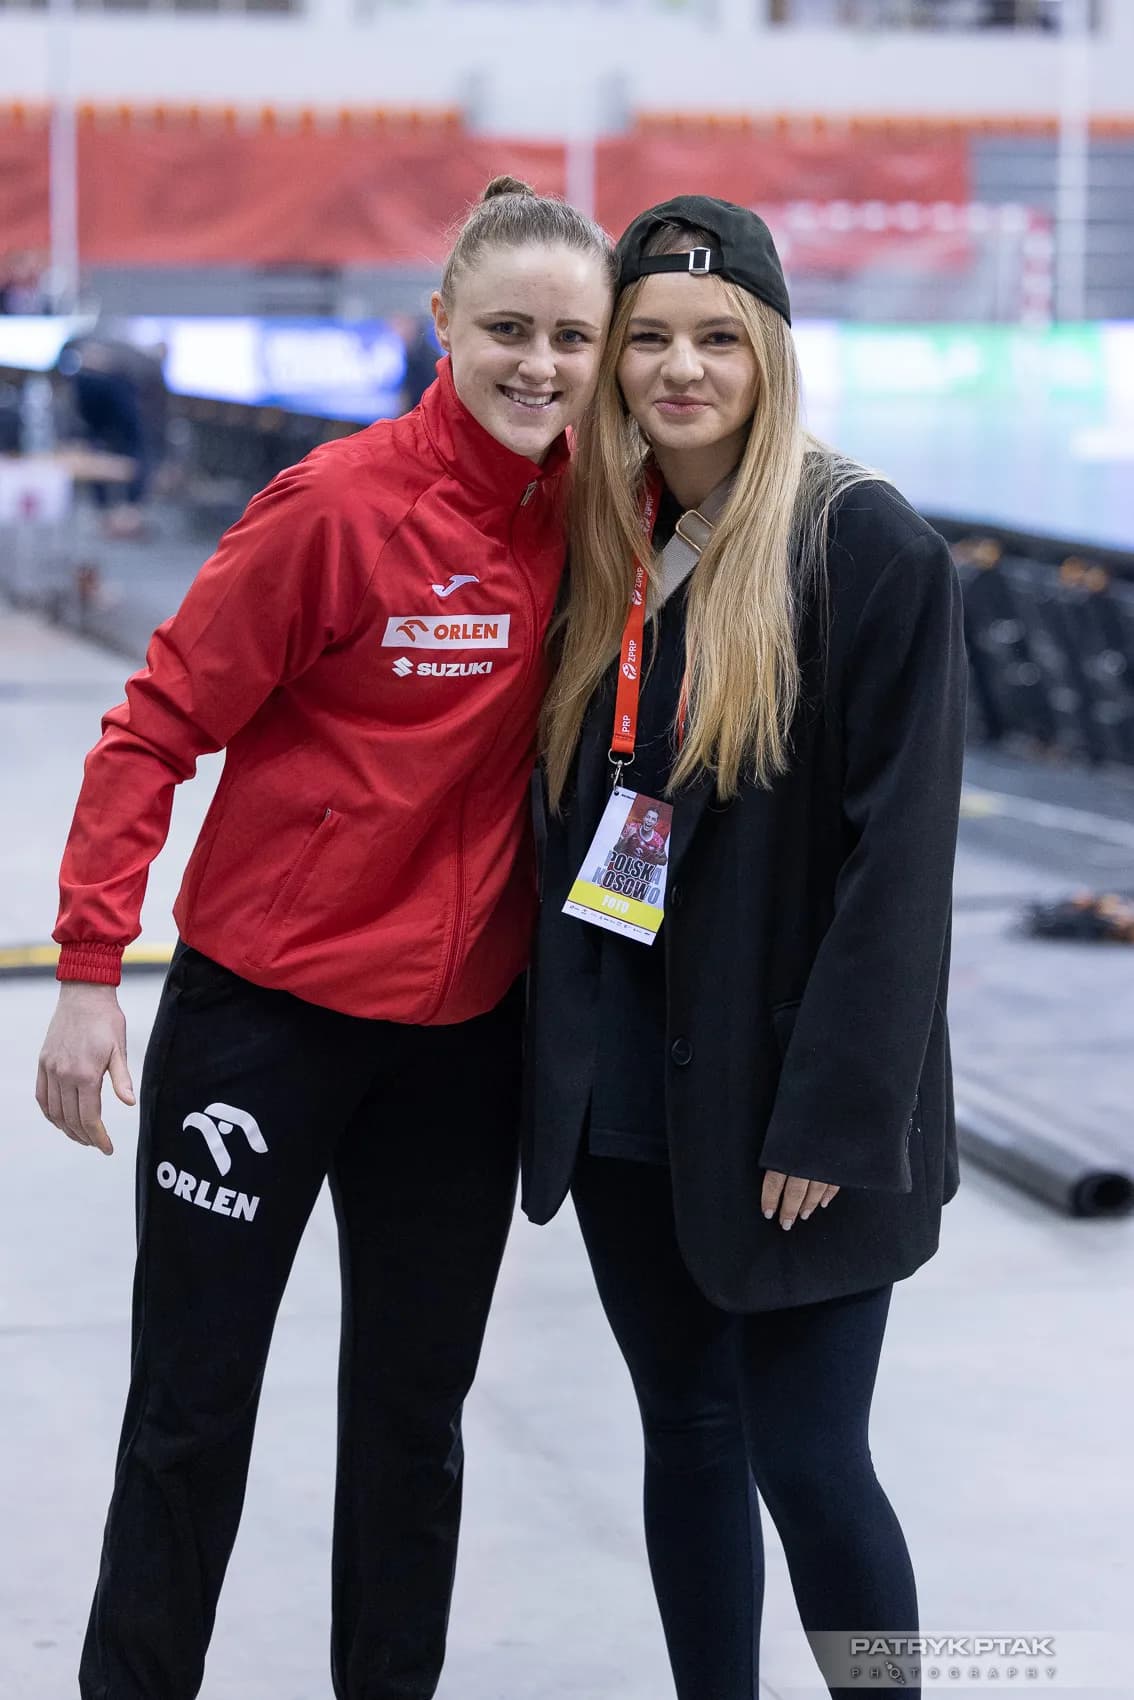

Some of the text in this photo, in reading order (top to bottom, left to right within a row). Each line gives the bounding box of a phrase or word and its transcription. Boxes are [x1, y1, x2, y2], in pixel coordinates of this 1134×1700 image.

[634, 567, 644, 588] ZPRP
[434, 624, 498, 640] ORLEN
[627, 640, 637, 663] ZPRP
[417, 661, 493, 676] SUZUKI
[622, 715, 630, 734] PRP
[604, 850, 662, 885] POLSKA
[592, 867, 661, 904] KOSOWO
[602, 895, 630, 913] FOTO
[156, 1161, 260, 1222] ORLEN
